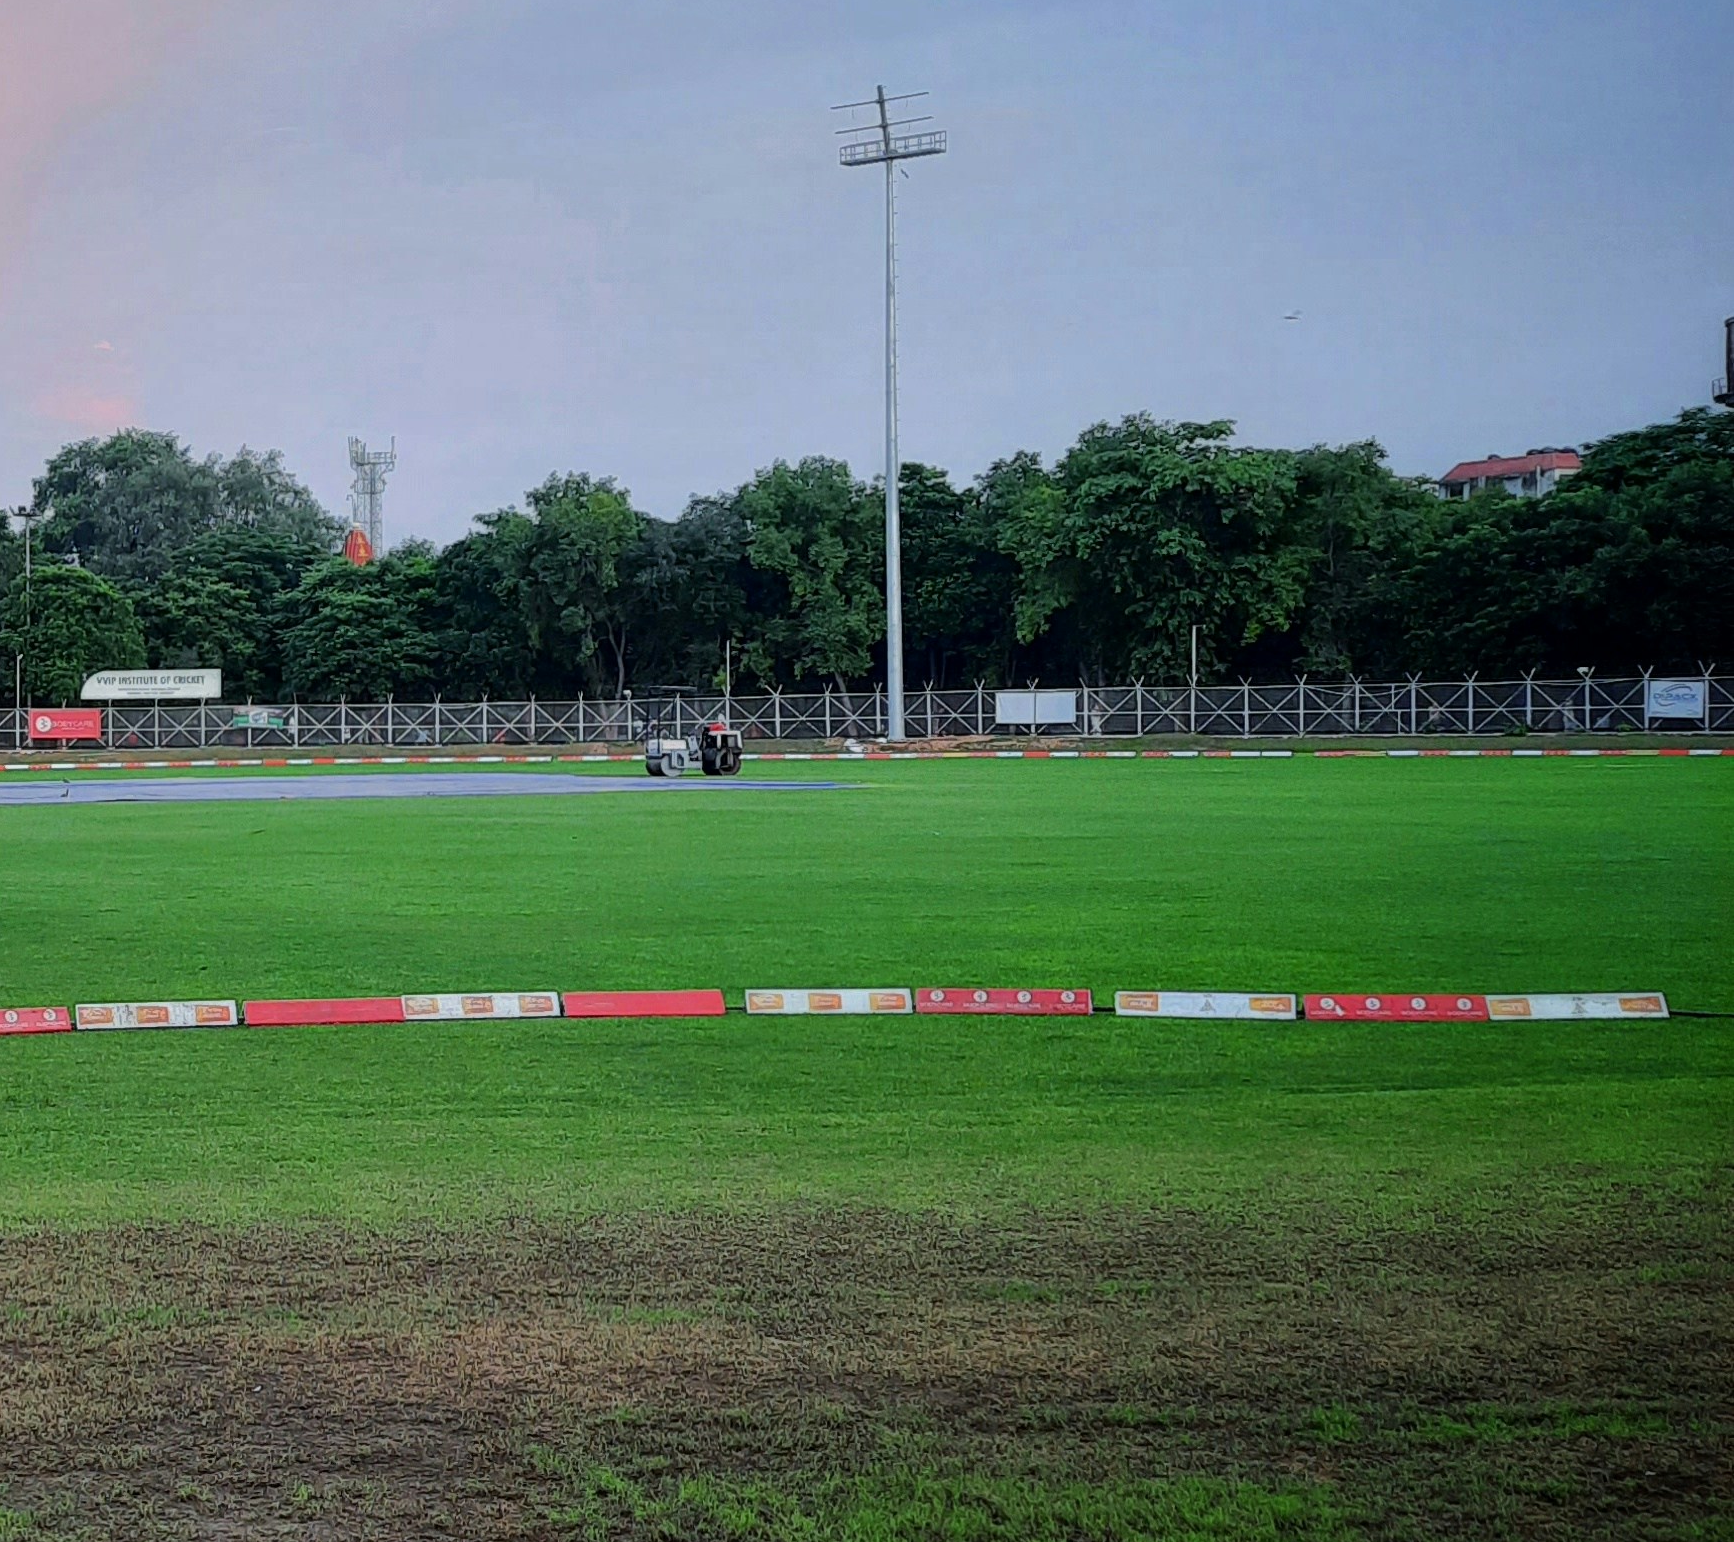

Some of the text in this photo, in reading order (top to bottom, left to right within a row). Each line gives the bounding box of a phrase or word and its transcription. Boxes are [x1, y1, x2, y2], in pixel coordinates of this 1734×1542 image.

[96, 675, 206, 685] VVIP INSTITUTE OF CRICKET
